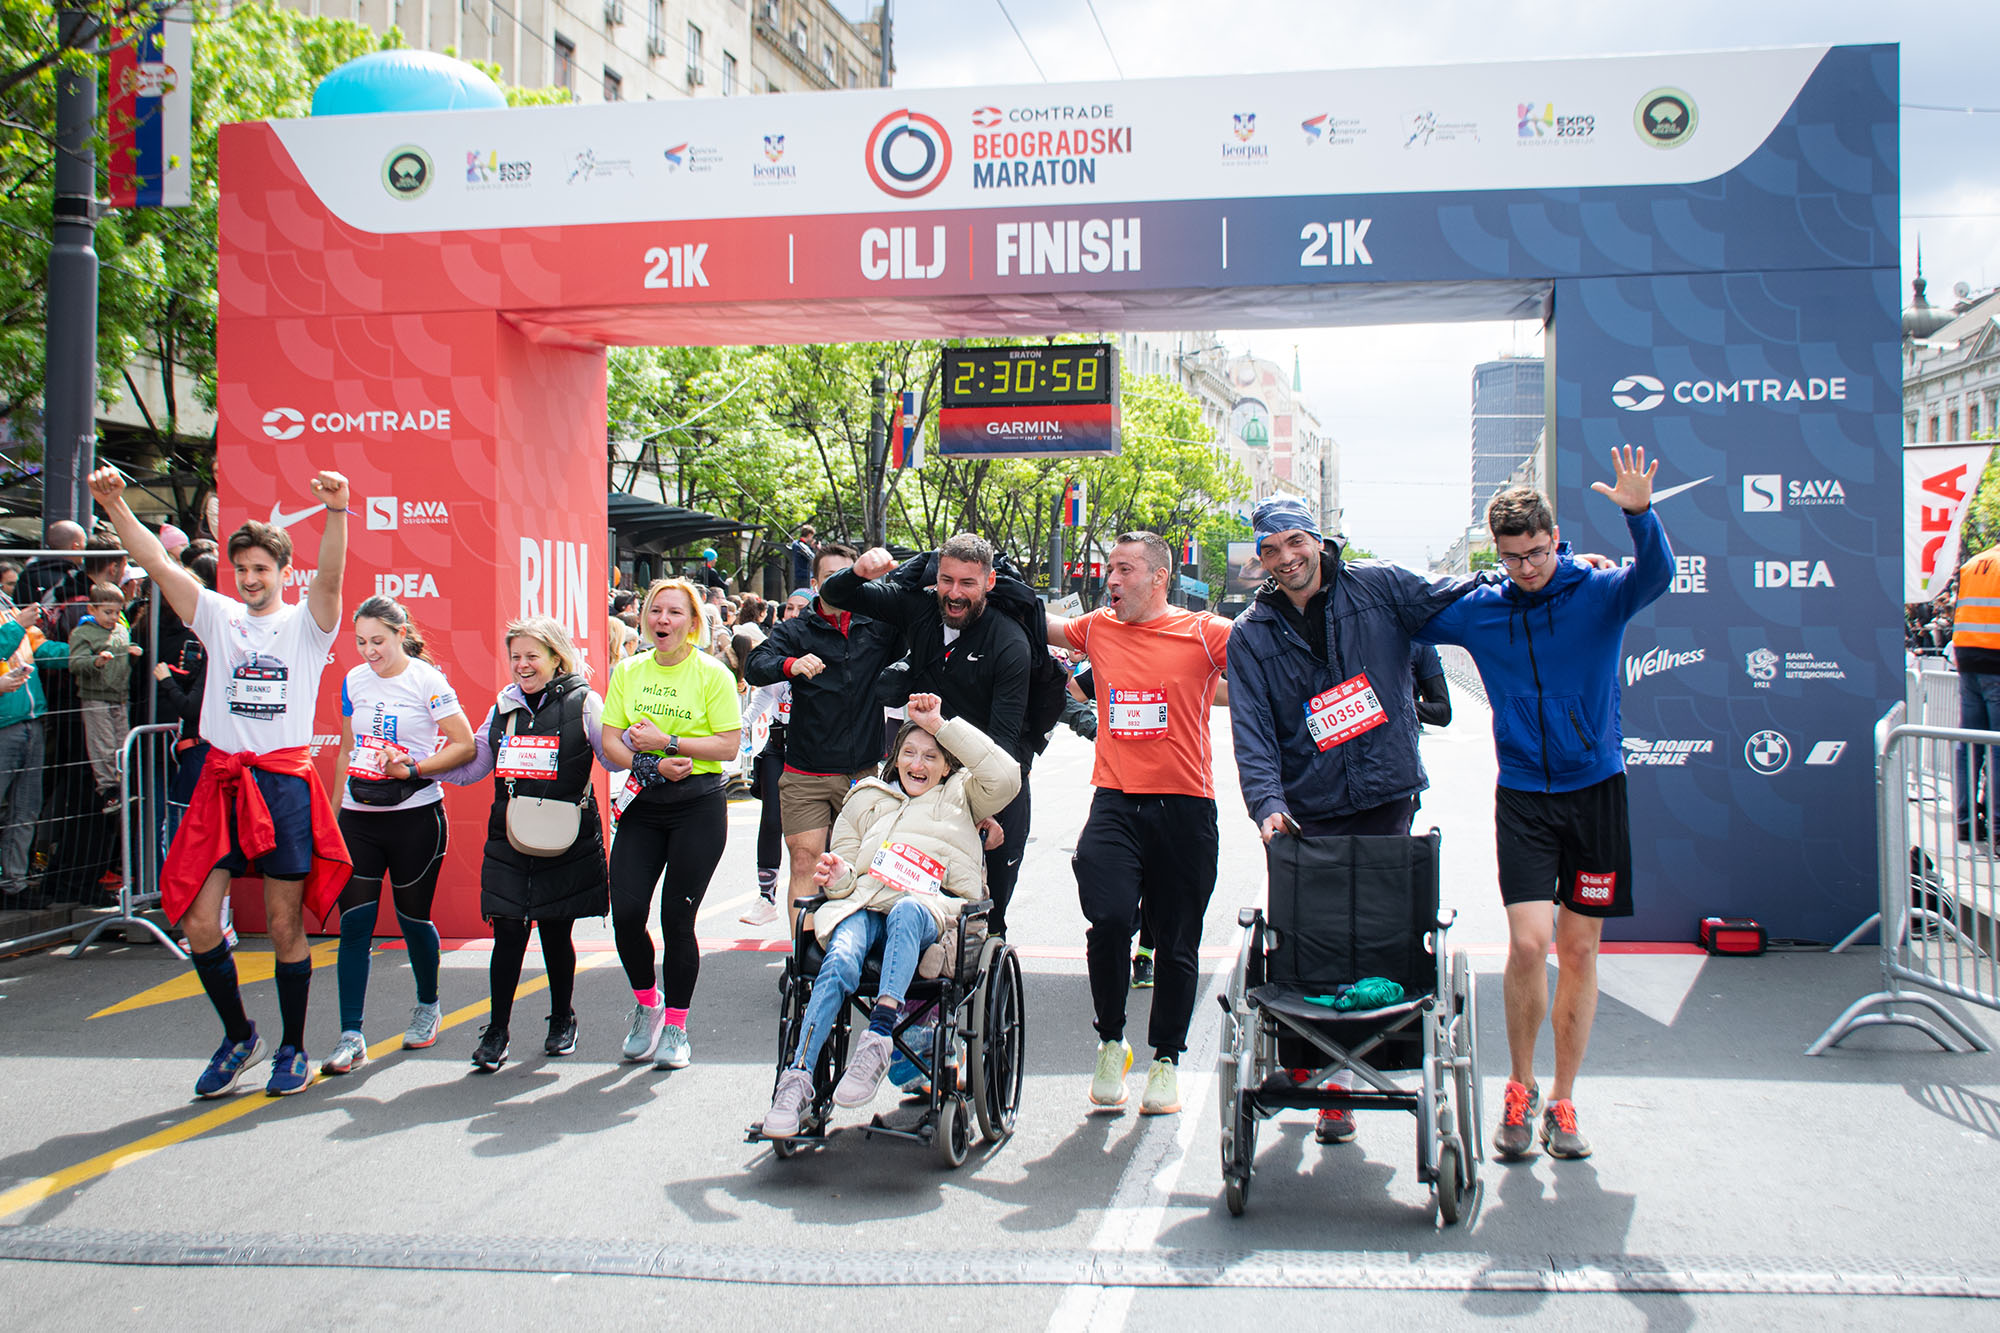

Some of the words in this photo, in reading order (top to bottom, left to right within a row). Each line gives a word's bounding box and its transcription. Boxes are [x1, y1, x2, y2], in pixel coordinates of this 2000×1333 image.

[1009, 104, 1113, 122] COMTRADE
[1557, 115, 1595, 126] EXPO
[1557, 126, 1595, 137] 2027
[973, 127, 1132, 160] BEOGRADSKI
[973, 158, 1095, 189] MARATON
[860, 225, 946, 281] CILJ
[996, 217, 1141, 276] FINISH
[1300, 218, 1373, 266] 21K
[643, 243, 709, 289] 21K
[1009, 351, 1042, 359] ERATON
[954, 358, 1098, 394] 2:30:58
[1672, 377, 1846, 403] COMTRADE
[311, 409, 451, 433] COMTRADE
[1788, 479, 1846, 498] SAVA
[403, 501, 449, 518] SAVA
[1788, 497, 1846, 506] OSIGURANJE
[403, 517, 449, 525] OSIGURANJE
[1974, 559, 1993, 575] TV
[520, 536, 588, 639] RUN
[1784, 652, 1815, 660] БАНКА
[1625, 646, 1705, 687] Wellness
[1784, 671, 1847, 679] ШТЕДИОНИЦА
[246, 684, 271, 693] BRANKO
[1127, 709, 1141, 718] VUK
[1320, 700, 1365, 730] 10356
[1652, 740, 1714, 753] ПОШТА
[1750, 733, 1784, 745] BMW
[519, 752, 537, 760] IVANA
[1625, 753, 1690, 765] СРБИЈЕ
[894, 861, 920, 882] BILJANA
[1581, 886, 1609, 899] 8828
